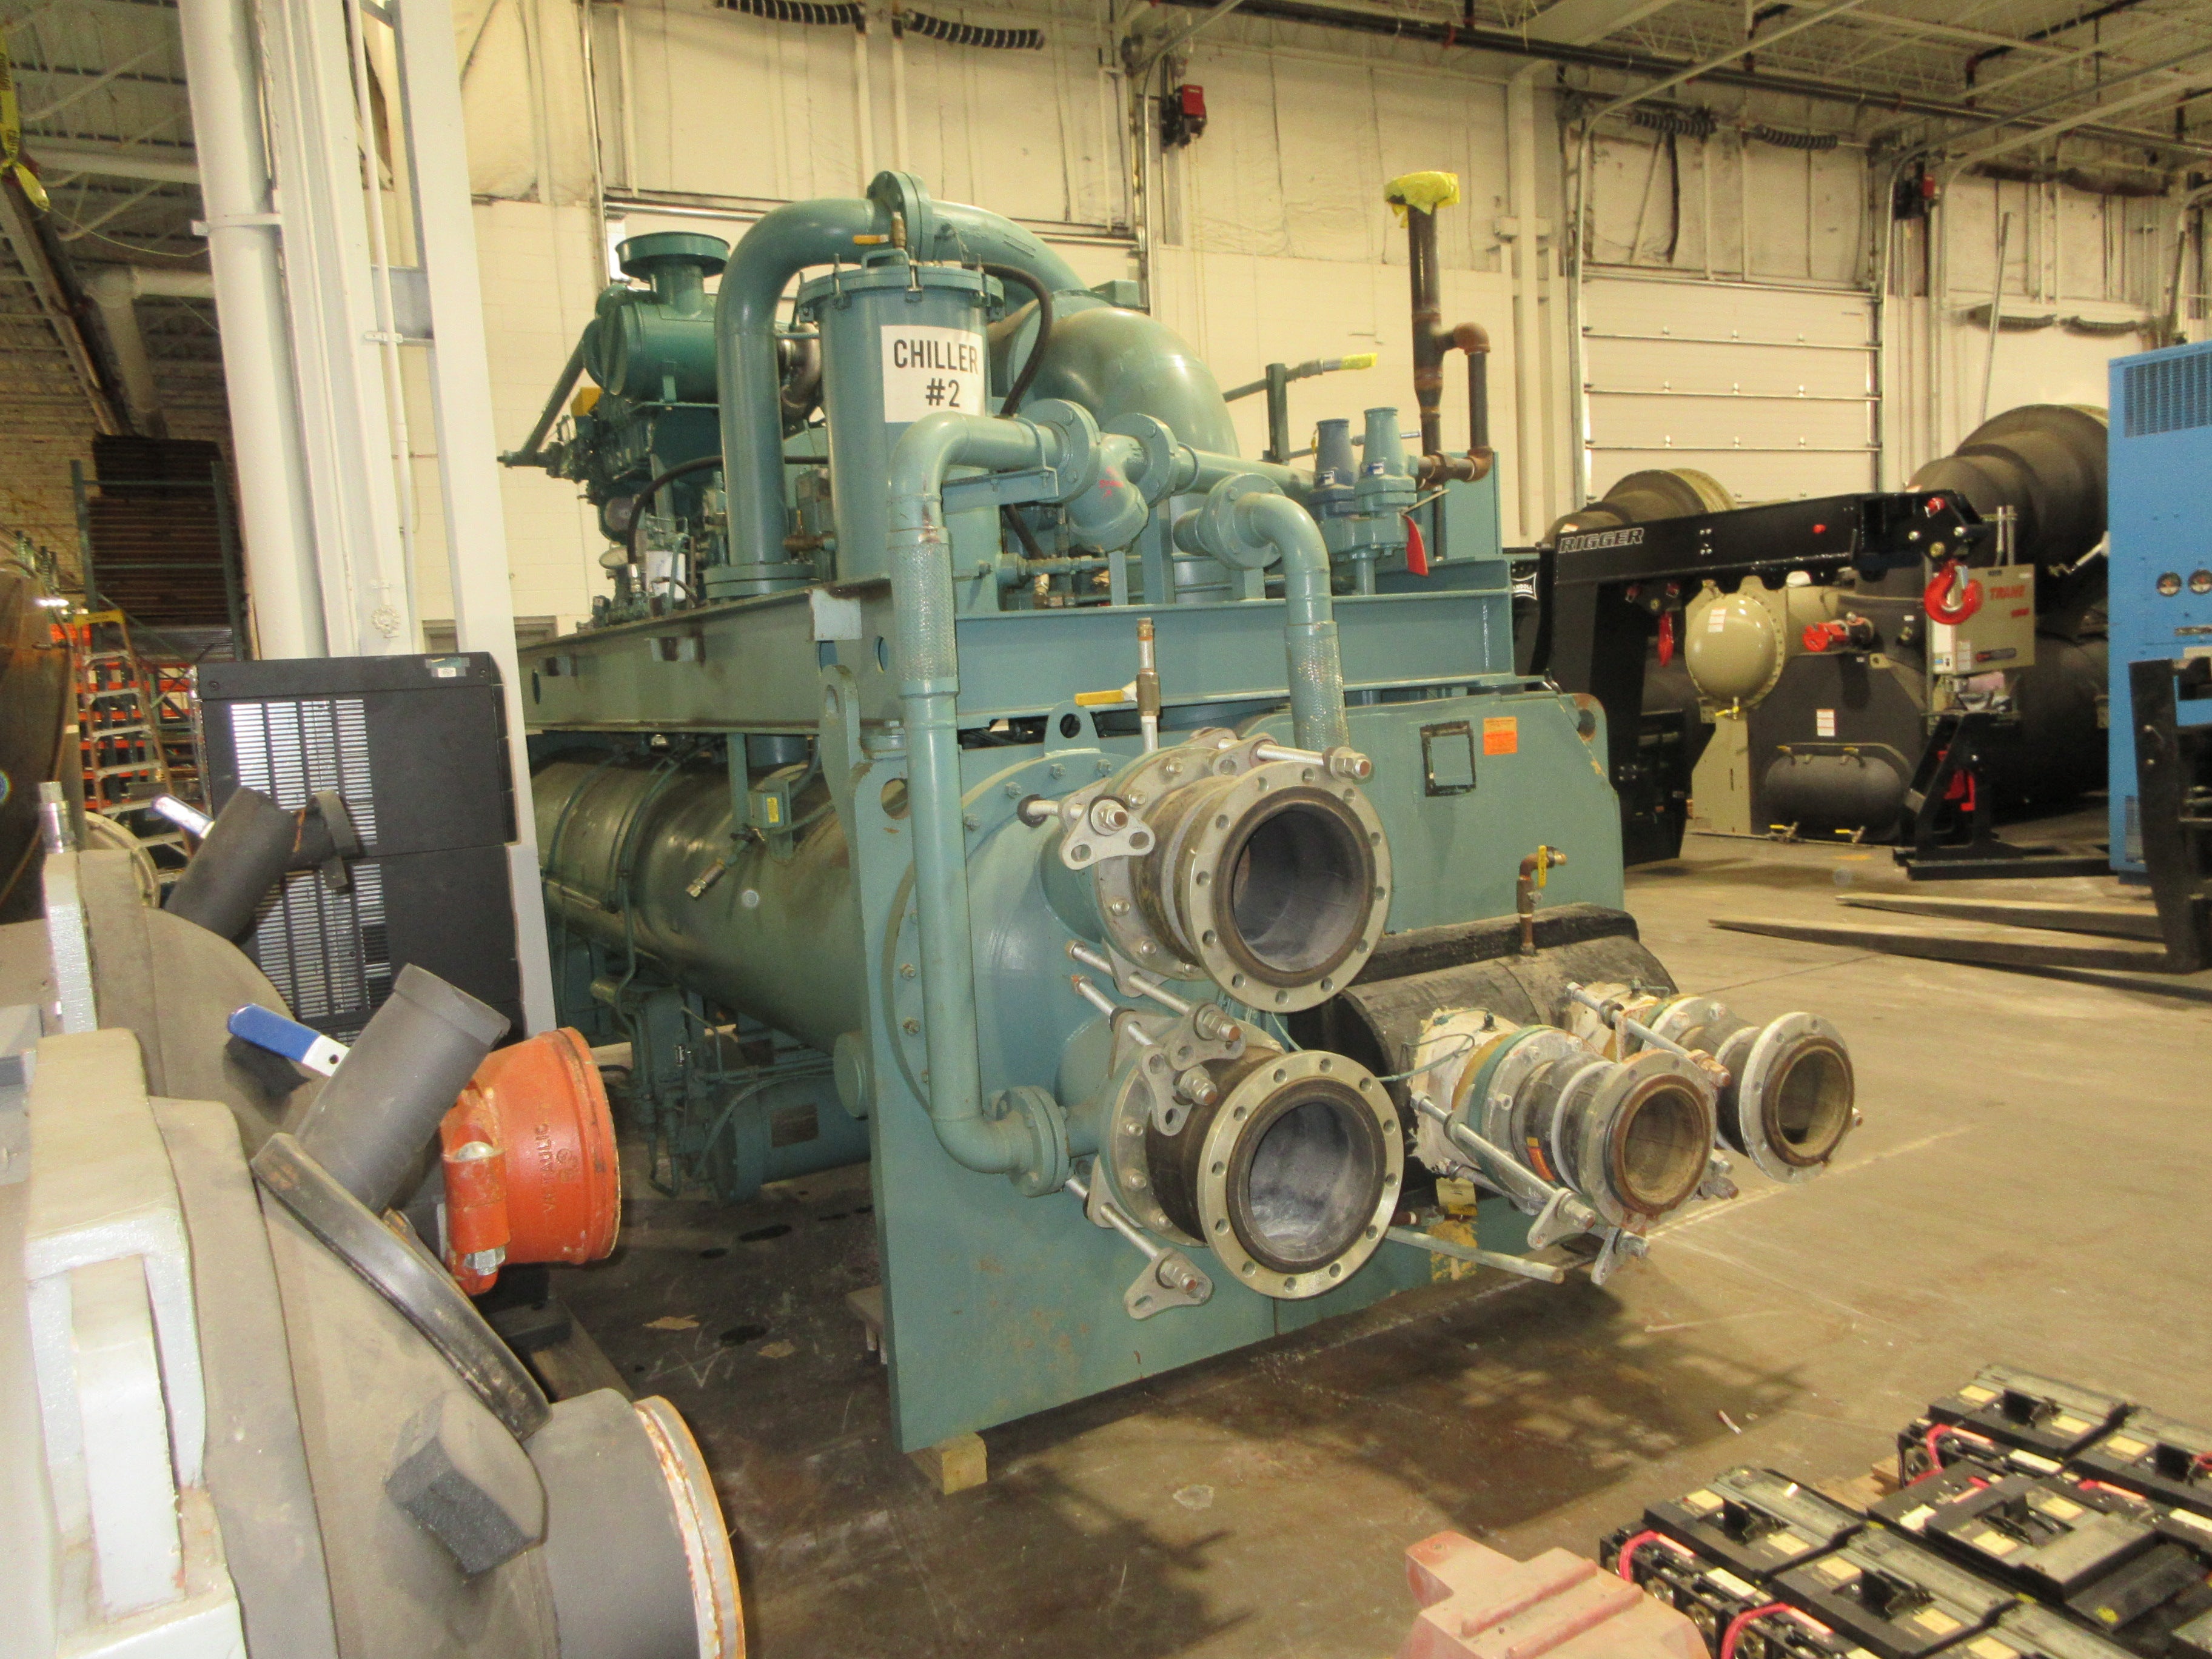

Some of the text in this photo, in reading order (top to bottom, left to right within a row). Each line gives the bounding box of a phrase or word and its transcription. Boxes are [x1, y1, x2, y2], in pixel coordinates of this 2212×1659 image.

[894, 339, 979, 374] CHILLER
[925, 377, 960, 407] #2
[1558, 527, 1644, 554] RIGGER
